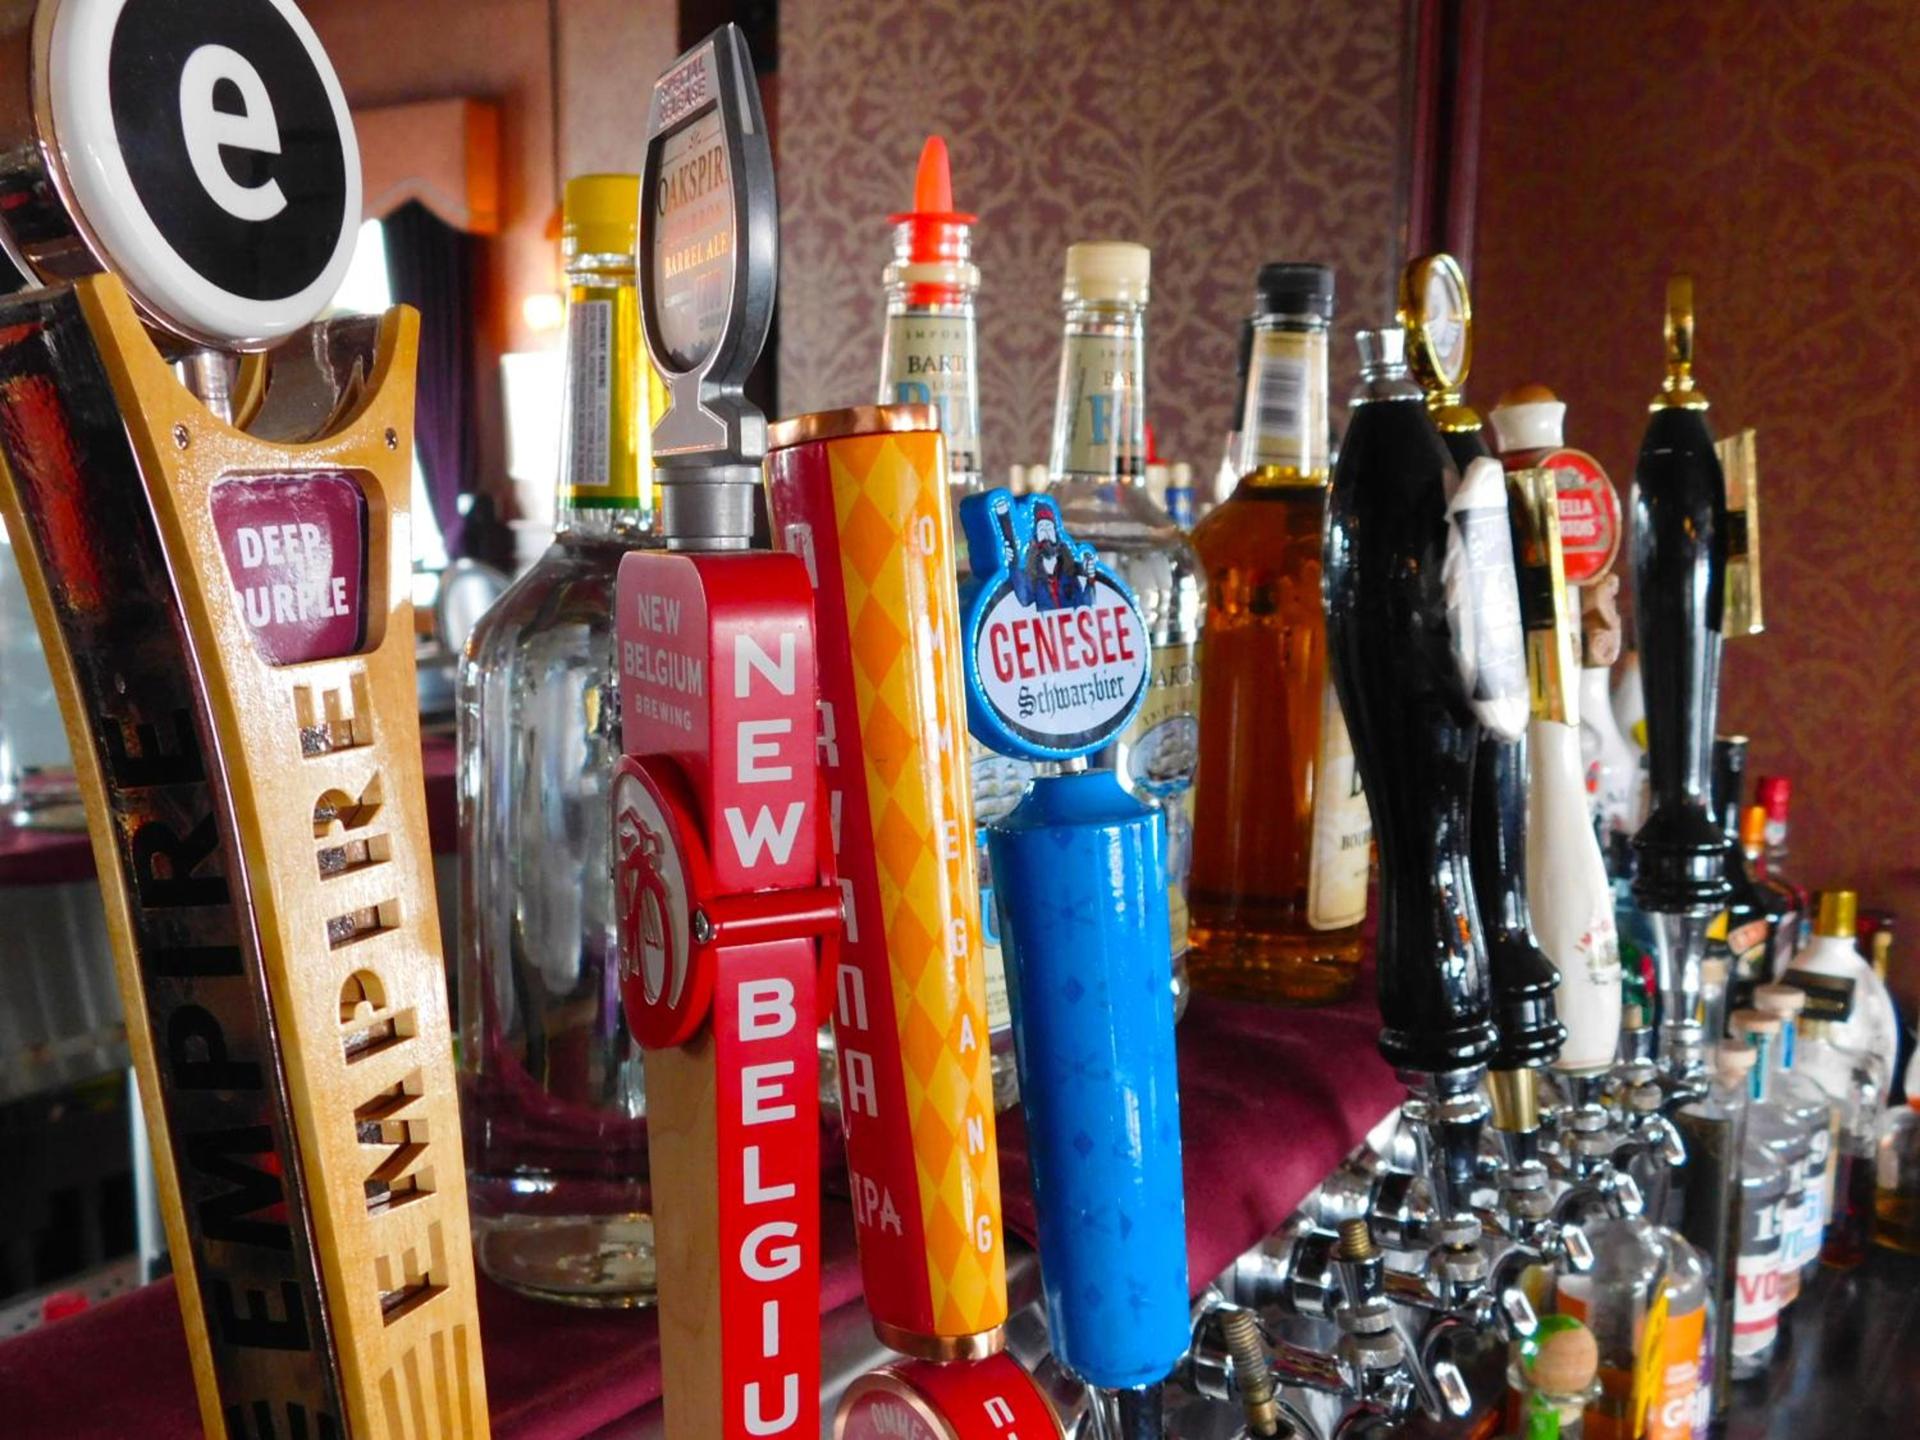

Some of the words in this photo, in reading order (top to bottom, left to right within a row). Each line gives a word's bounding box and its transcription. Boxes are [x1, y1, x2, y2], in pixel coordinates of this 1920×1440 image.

[179, 44, 288, 222] e
[657, 145, 726, 218] OAKSPIR
[706, 231, 728, 261] ALE
[237, 523, 321, 568] DEEP
[233, 577, 349, 627] PURPLE
[637, 594, 680, 636] NEW
[623, 641, 702, 697] BELGIUM
[989, 606, 1135, 684] GENESEE
[635, 694, 692, 731] BREWING
[1017, 670, 1125, 718] Schwarzbier
[724, 632, 806, 868] NEW
[103, 706, 311, 1351] EMPIRE
[293, 671, 450, 1327] EMPIRE
[737, 977, 802, 1436] BELGIU
[852, 1171, 903, 1237] IPA
